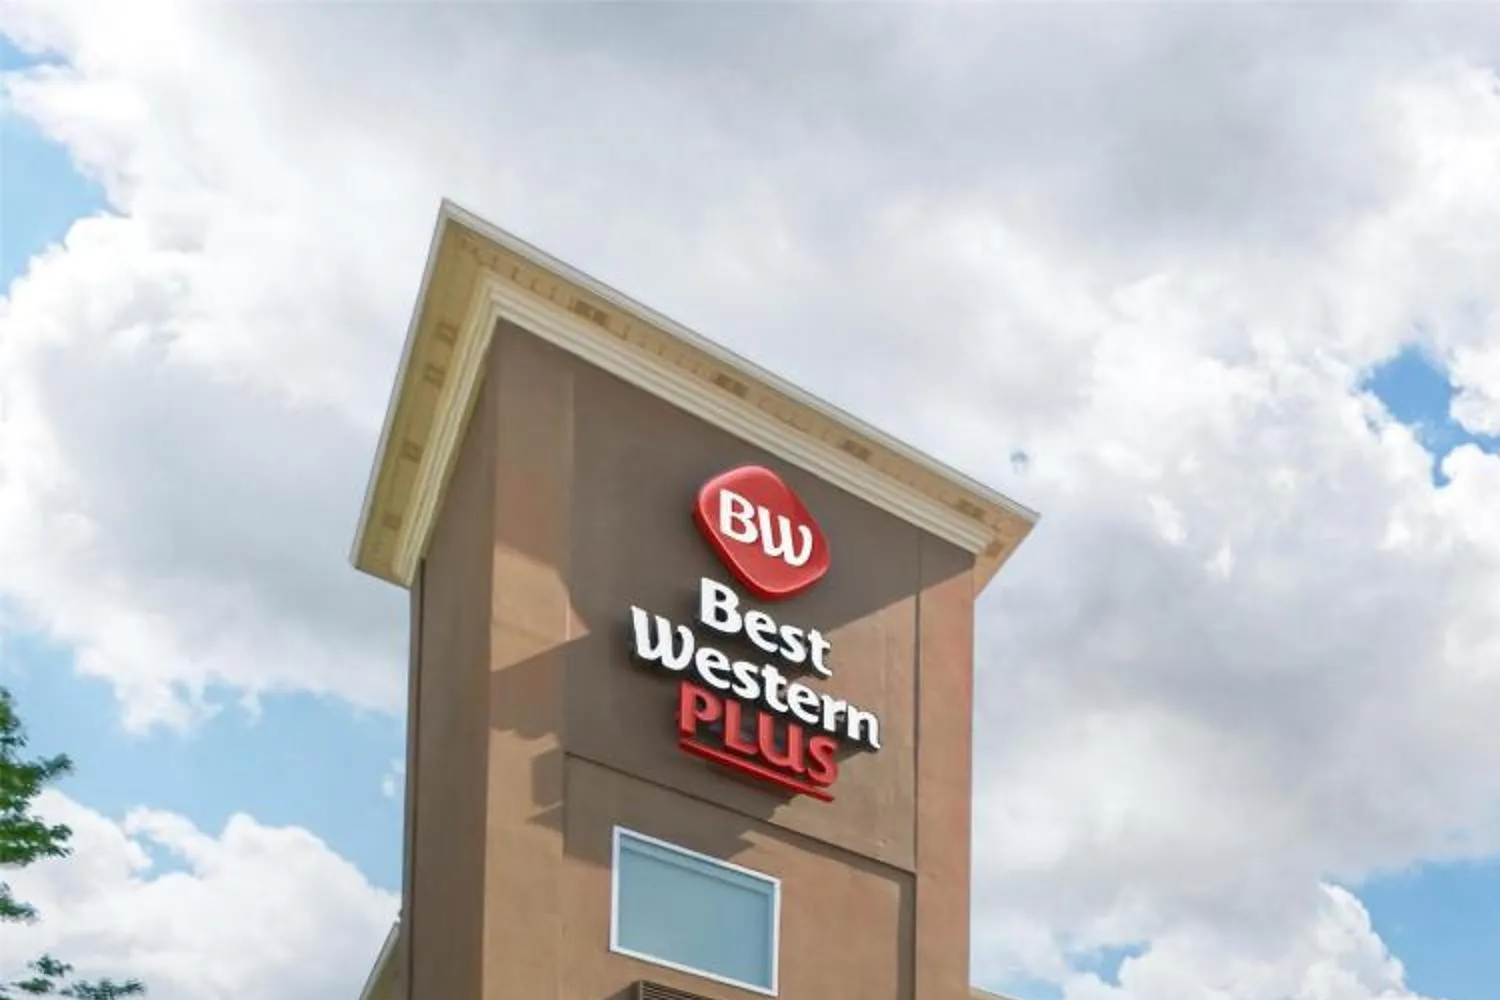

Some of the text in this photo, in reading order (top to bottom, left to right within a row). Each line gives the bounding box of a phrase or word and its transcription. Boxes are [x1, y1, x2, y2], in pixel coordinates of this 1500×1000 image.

[719, 488, 812, 566] BW
[631, 605, 881, 750] Western
[701, 577, 832, 677] Best
[677, 681, 838, 787] PLUS
